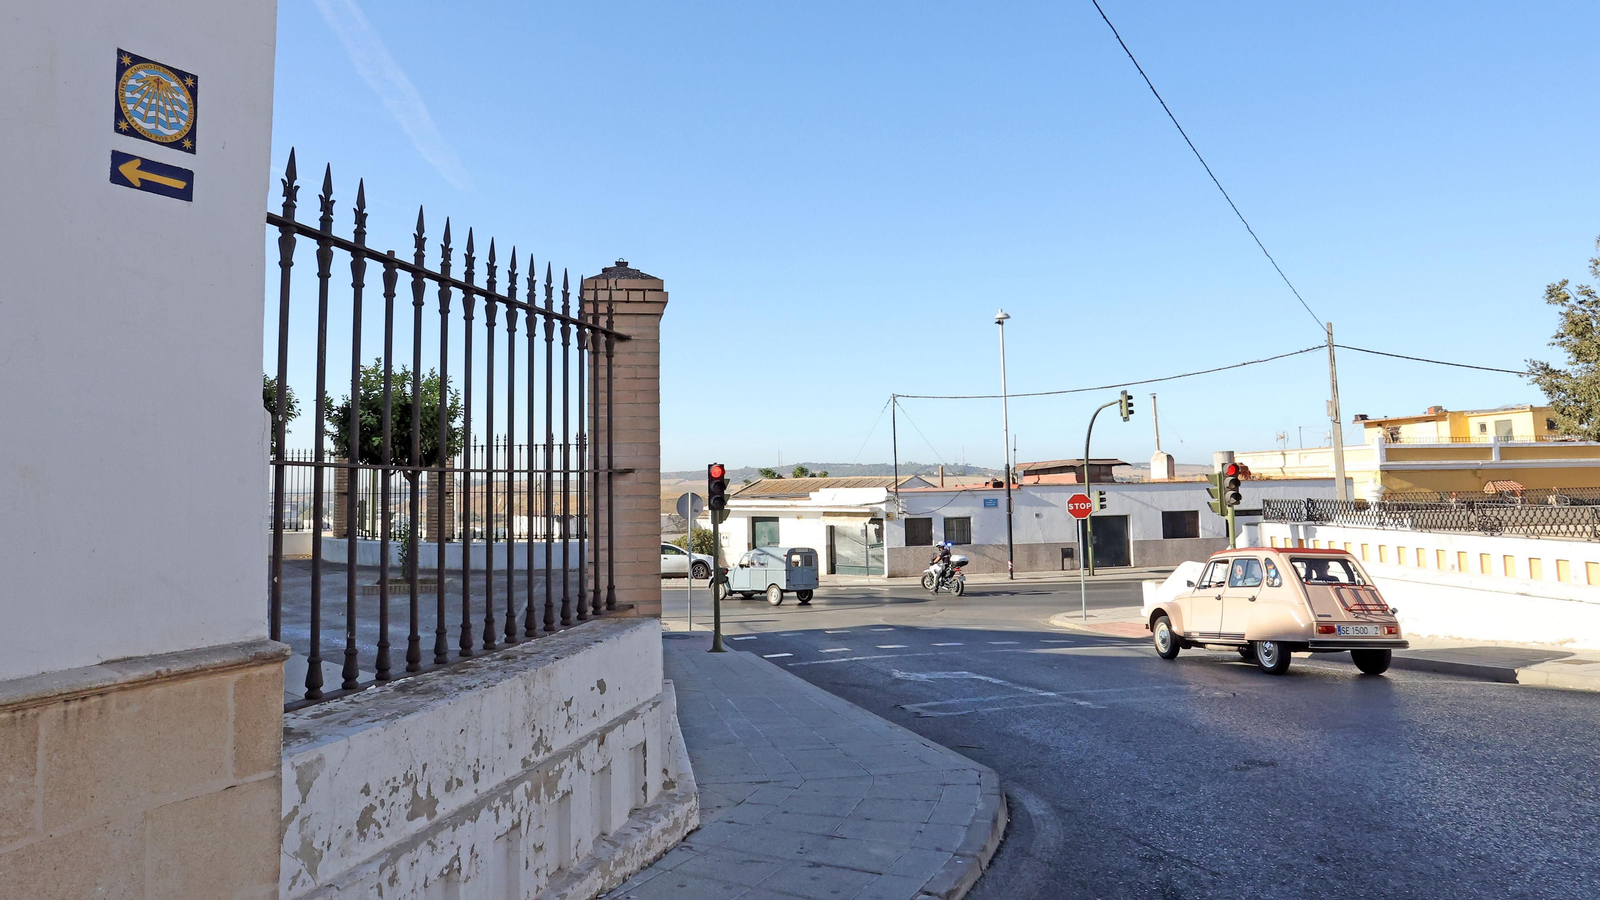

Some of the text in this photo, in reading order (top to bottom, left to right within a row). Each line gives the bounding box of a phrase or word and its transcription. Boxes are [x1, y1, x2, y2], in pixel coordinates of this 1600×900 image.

[120, 75, 129, 103] CAMINO
[130, 65, 152, 74] CAMINO
[162, 68, 186, 92] SANTIAGO
